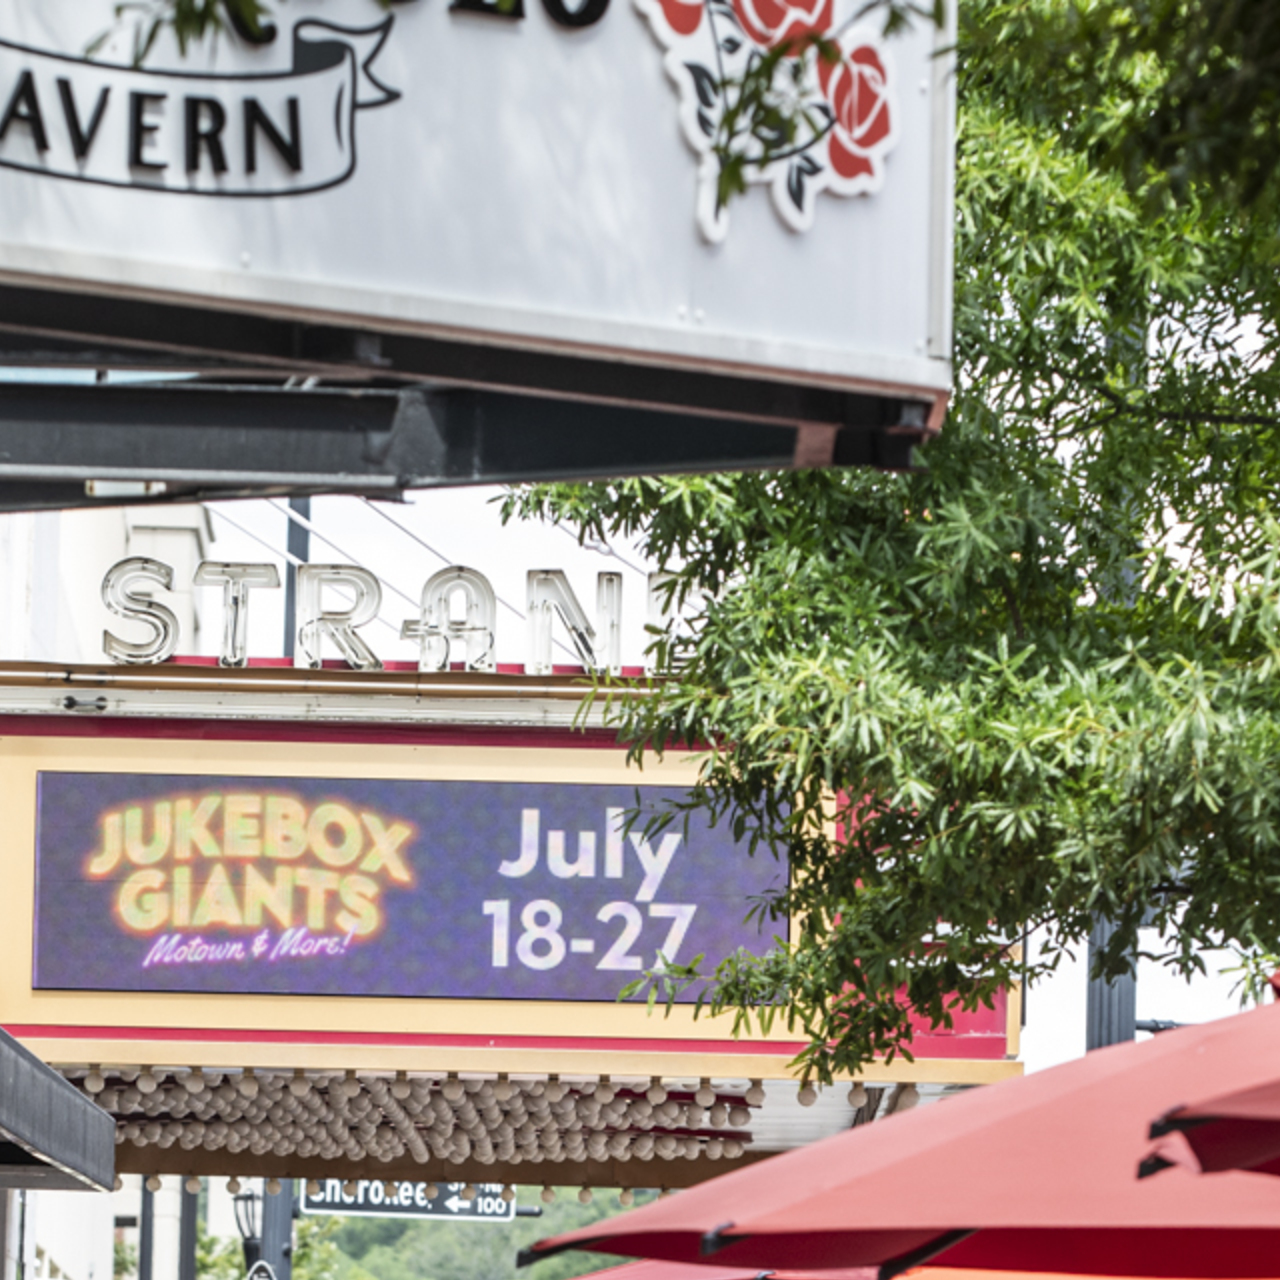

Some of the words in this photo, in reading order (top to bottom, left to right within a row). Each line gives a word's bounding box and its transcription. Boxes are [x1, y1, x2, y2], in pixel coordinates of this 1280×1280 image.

[88, 793, 413, 883] JUKEBOX
[498, 807, 682, 902] July
[118, 863, 381, 935] GIANTS
[482, 899, 698, 970] 18-27
[142, 933, 245, 967] Motown
[251, 929, 269, 958] &
[269, 924, 358, 961] More!
[477, 1196, 507, 1214] 100
